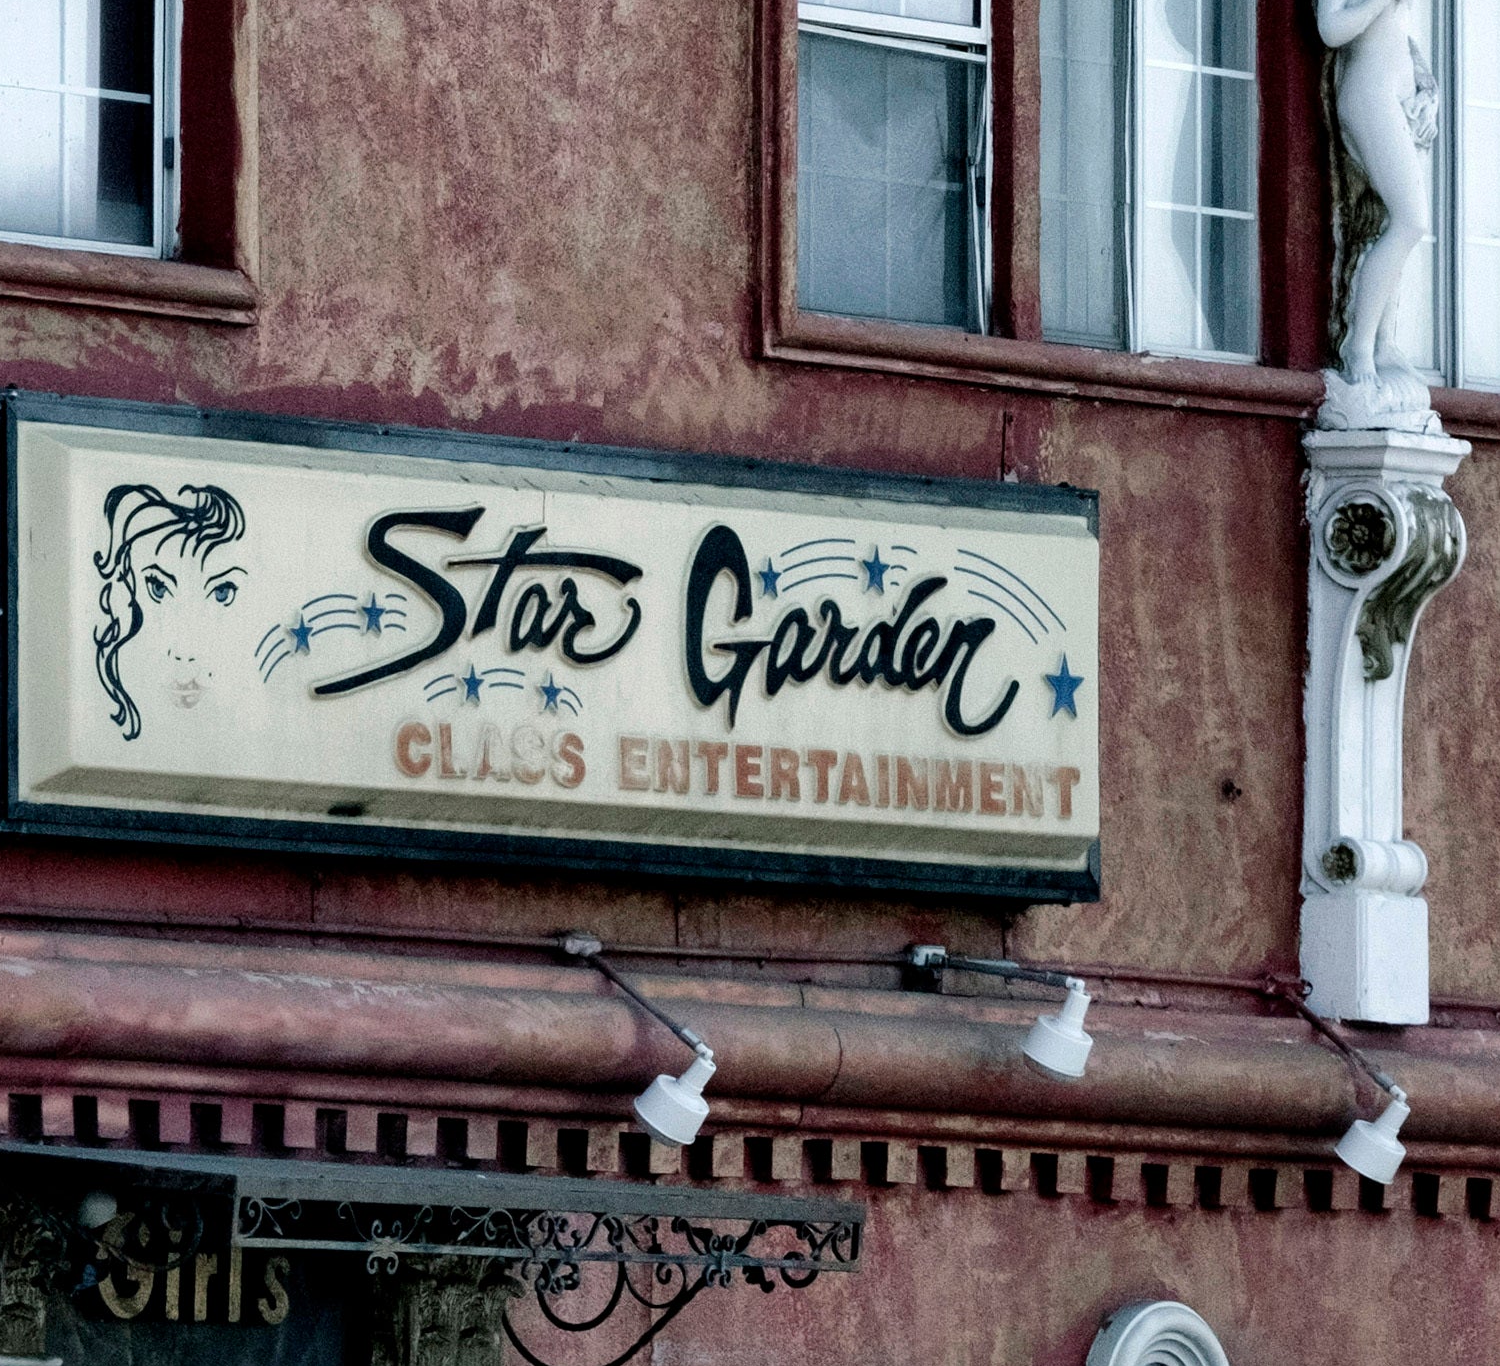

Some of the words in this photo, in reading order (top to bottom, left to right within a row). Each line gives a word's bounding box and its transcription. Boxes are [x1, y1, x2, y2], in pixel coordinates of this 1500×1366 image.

[314, 504, 643, 695] Star
[685, 524, 1020, 736] Garden
[395, 721, 587, 788] CLASS
[618, 735, 1082, 819] ENTERTAINMENT
